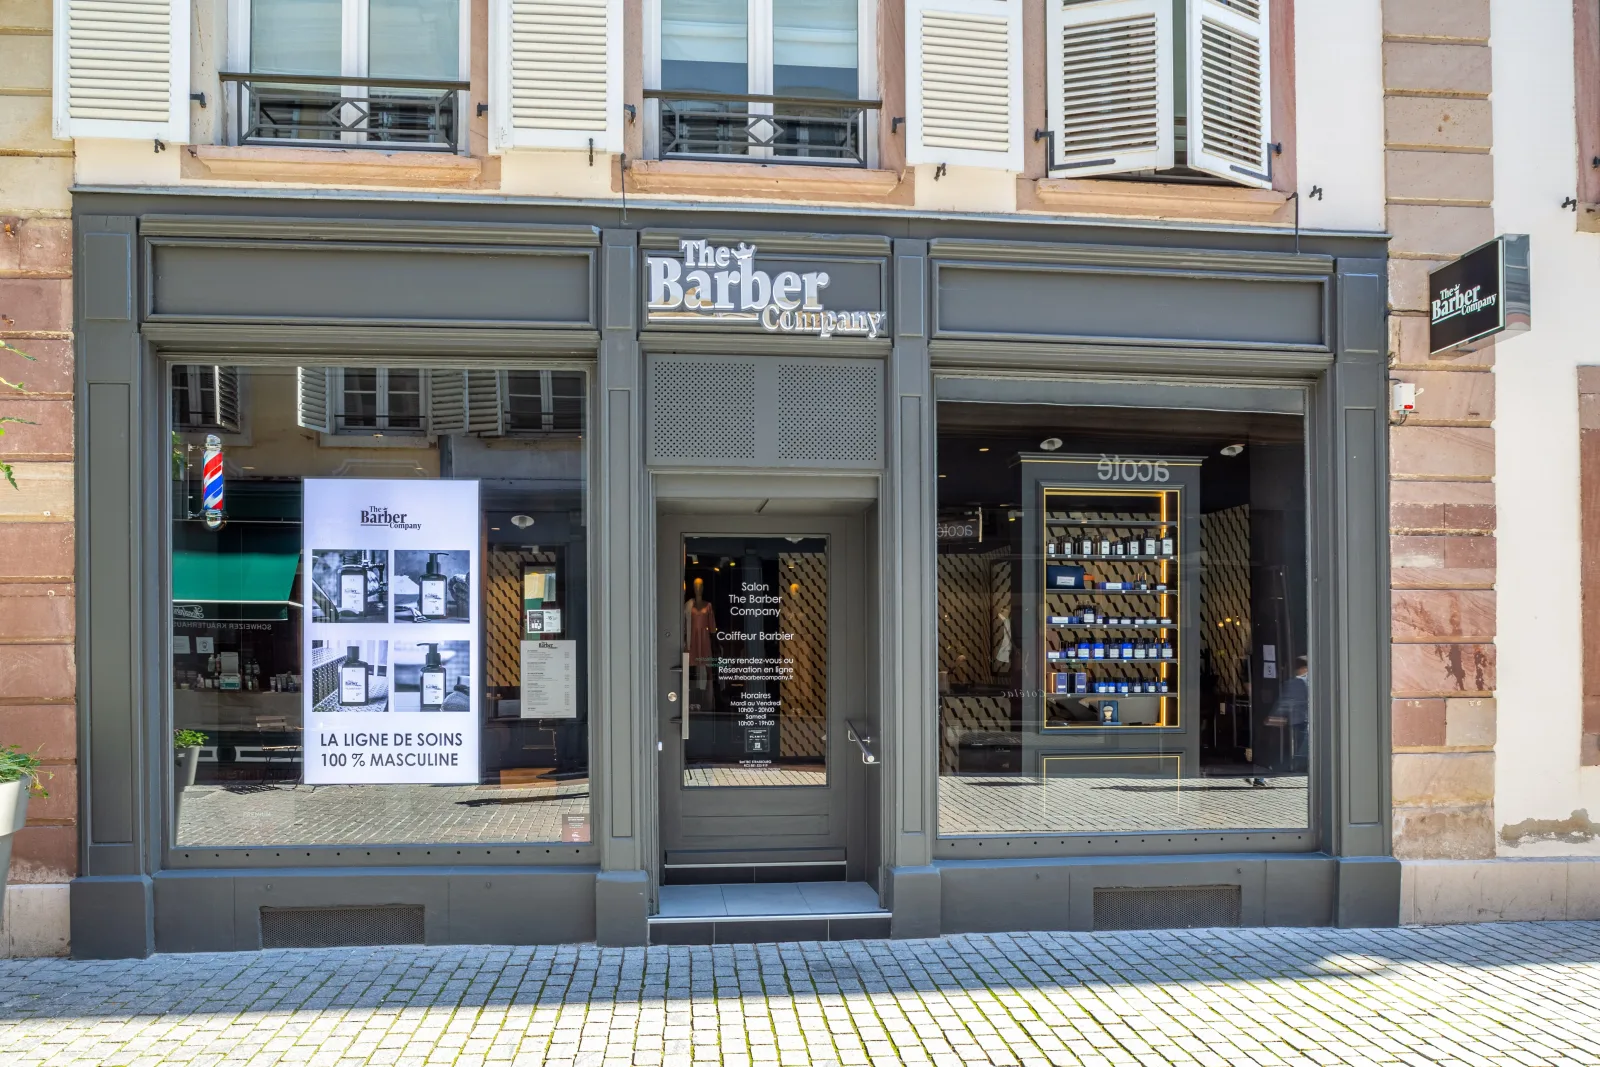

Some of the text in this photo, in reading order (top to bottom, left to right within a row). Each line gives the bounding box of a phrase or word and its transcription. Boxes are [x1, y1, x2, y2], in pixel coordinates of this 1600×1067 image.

[680, 239, 731, 267] The
[647, 256, 830, 311] Barber
[1440, 287, 1454, 301] The
[1432, 285, 1480, 320] Barber
[1461, 293, 1497, 315] Company
[762, 303, 885, 339] Company
[369, 505, 382, 513] The
[360, 509, 407, 524] Barber
[389, 522, 422, 531] Company
[741, 581, 769, 591] Salon
[728, 594, 782, 604] The Barber
[730, 606, 781, 618] Company
[716, 631, 794, 641] Coiffeur Barbier
[718, 656, 736, 664] Sans
[736, 656, 782, 664] rendez-vous
[718, 665, 762, 674] Réservation
[775, 666, 794, 675] ligne
[740, 691, 772, 699] Horaires
[320, 733, 463, 747] LA LIGNE DE SOINS
[321, 752, 458, 768] 100 % MASCULINE
